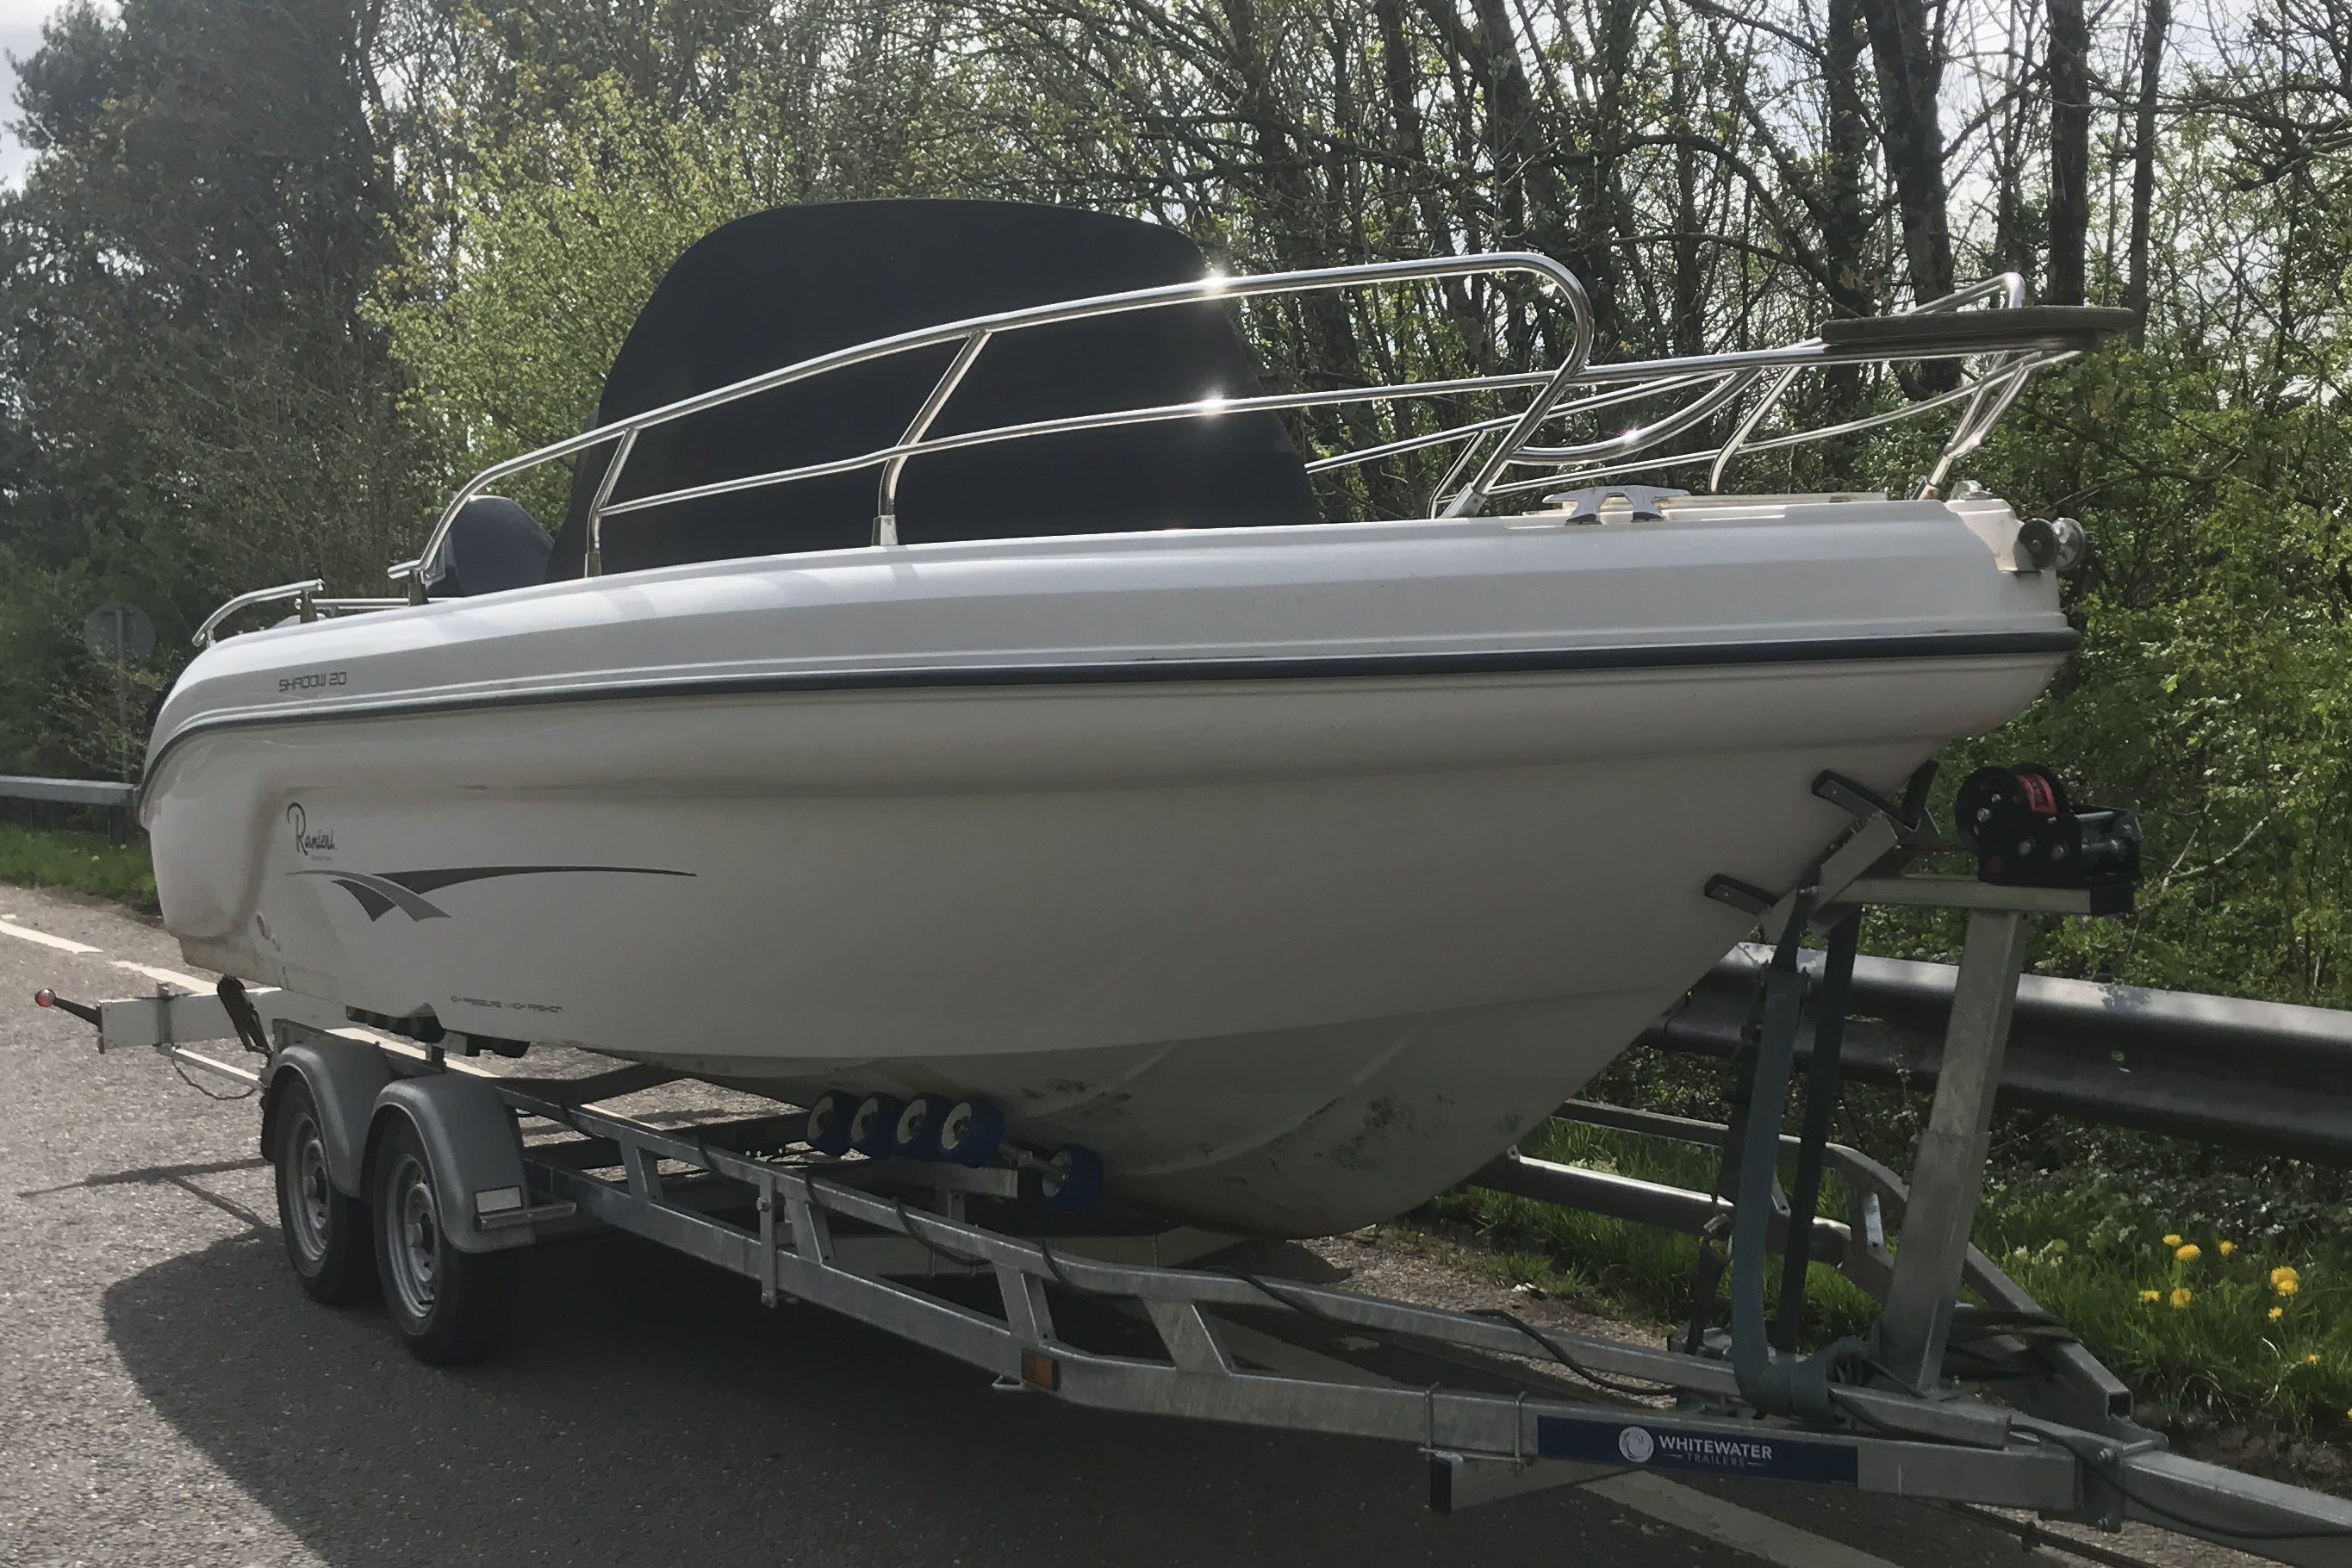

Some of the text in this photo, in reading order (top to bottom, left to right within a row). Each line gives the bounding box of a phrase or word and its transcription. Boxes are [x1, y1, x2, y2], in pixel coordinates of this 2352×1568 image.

[278, 671, 347, 693] SHADOW 20
[1658, 1434, 1773, 1460] WHITEWATER
[1687, 1453, 1746, 1467] TRAILERS
